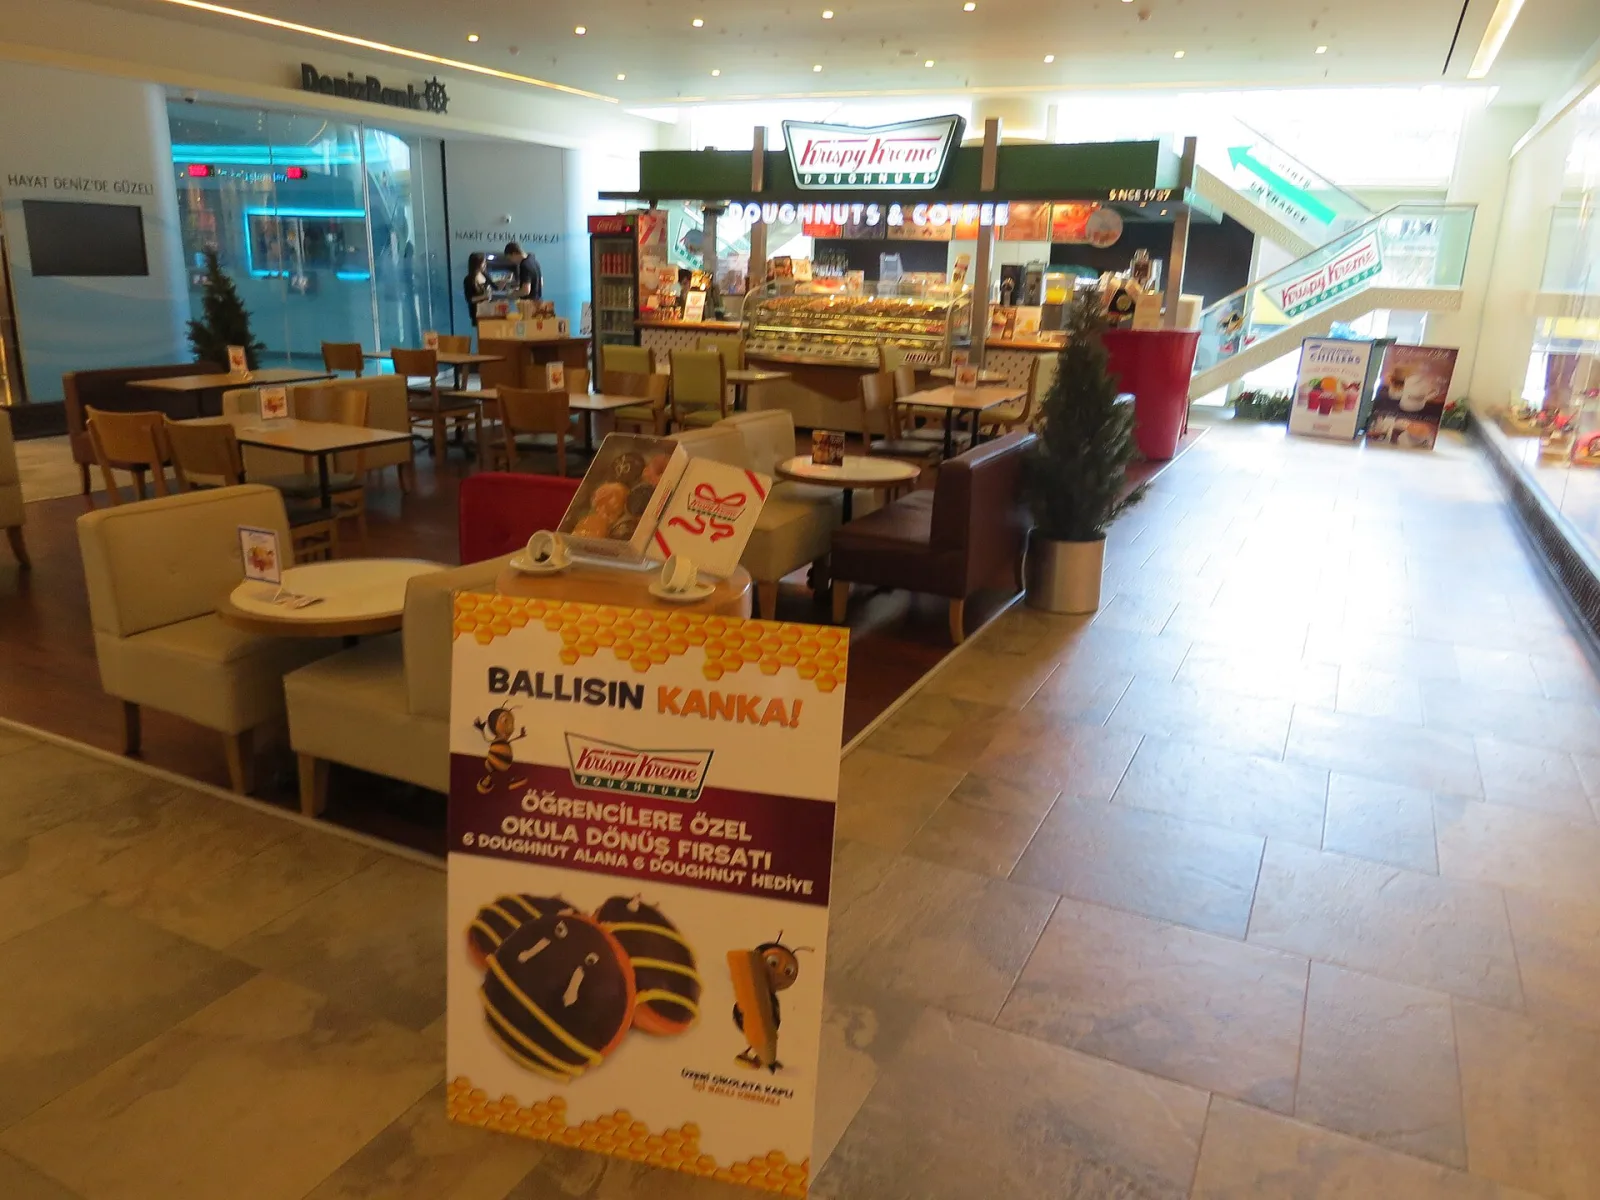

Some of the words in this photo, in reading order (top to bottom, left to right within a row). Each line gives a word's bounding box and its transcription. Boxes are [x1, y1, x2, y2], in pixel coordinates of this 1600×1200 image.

[300, 62, 421, 110] DenizBank
[800, 139, 870, 173] Krispy
[867, 136, 942, 165] Kreme
[7, 175, 50, 189] HAYAT
[803, 173, 932, 185] DOUGHNUTS
[728, 202, 882, 227] DOUGHNUTS
[886, 203, 904, 227] &
[911, 202, 1010, 227] COFFEE
[1281, 269, 1326, 309] Krispy
[1326, 243, 1375, 285] Kreme
[488, 667, 644, 710] BALLISIN
[657, 685, 803, 728] KANKA!
[576, 748, 640, 780] Krispy
[636, 753, 701, 781] Kreme
[580, 775, 694, 798] DOUGHNUTS
[521, 789, 683, 832] ÖĞRENCİLERE
[690, 811, 752, 842] ÖZEL
[462, 832, 475, 846] 6
[478, 833, 569, 859] DOUGHNUT
[573, 848, 628, 868] ALANA
[632, 856, 645, 870] 6
[649, 857, 747, 885] DOUGHNUT
[751, 872, 813, 895] HEDİYE
[501, 815, 579, 843] OKULA
[586, 825, 670, 860] DÖNÜŞ
[678, 840, 772, 870] FIRSATI
